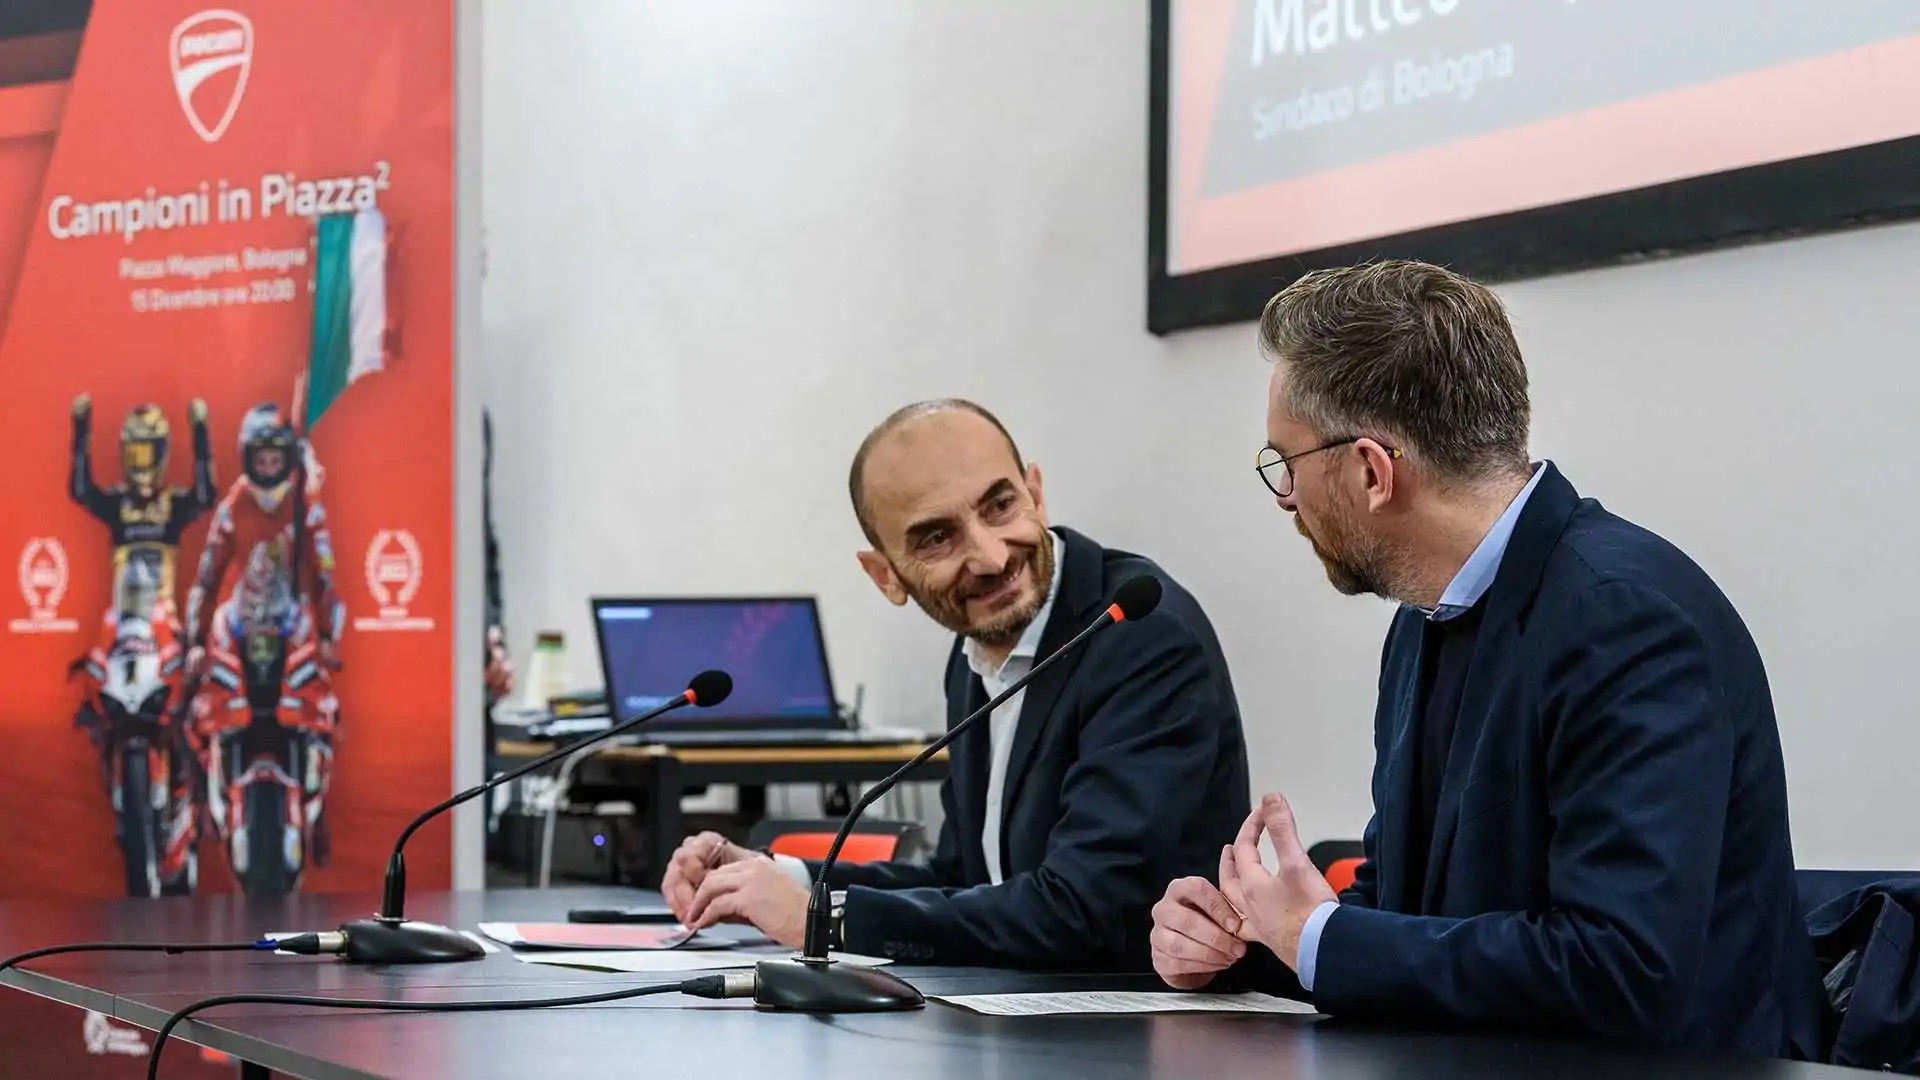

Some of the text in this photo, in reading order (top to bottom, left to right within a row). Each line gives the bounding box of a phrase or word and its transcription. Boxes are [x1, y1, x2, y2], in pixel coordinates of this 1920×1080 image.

[1252, 82, 1354, 140] Sindaco
[1393, 43, 1514, 103] Bologna
[49, 181, 209, 243] Campioni
[218, 178, 251, 222] in
[119, 257, 167, 281] Piazza
[243, 247, 307, 273] Bologna
